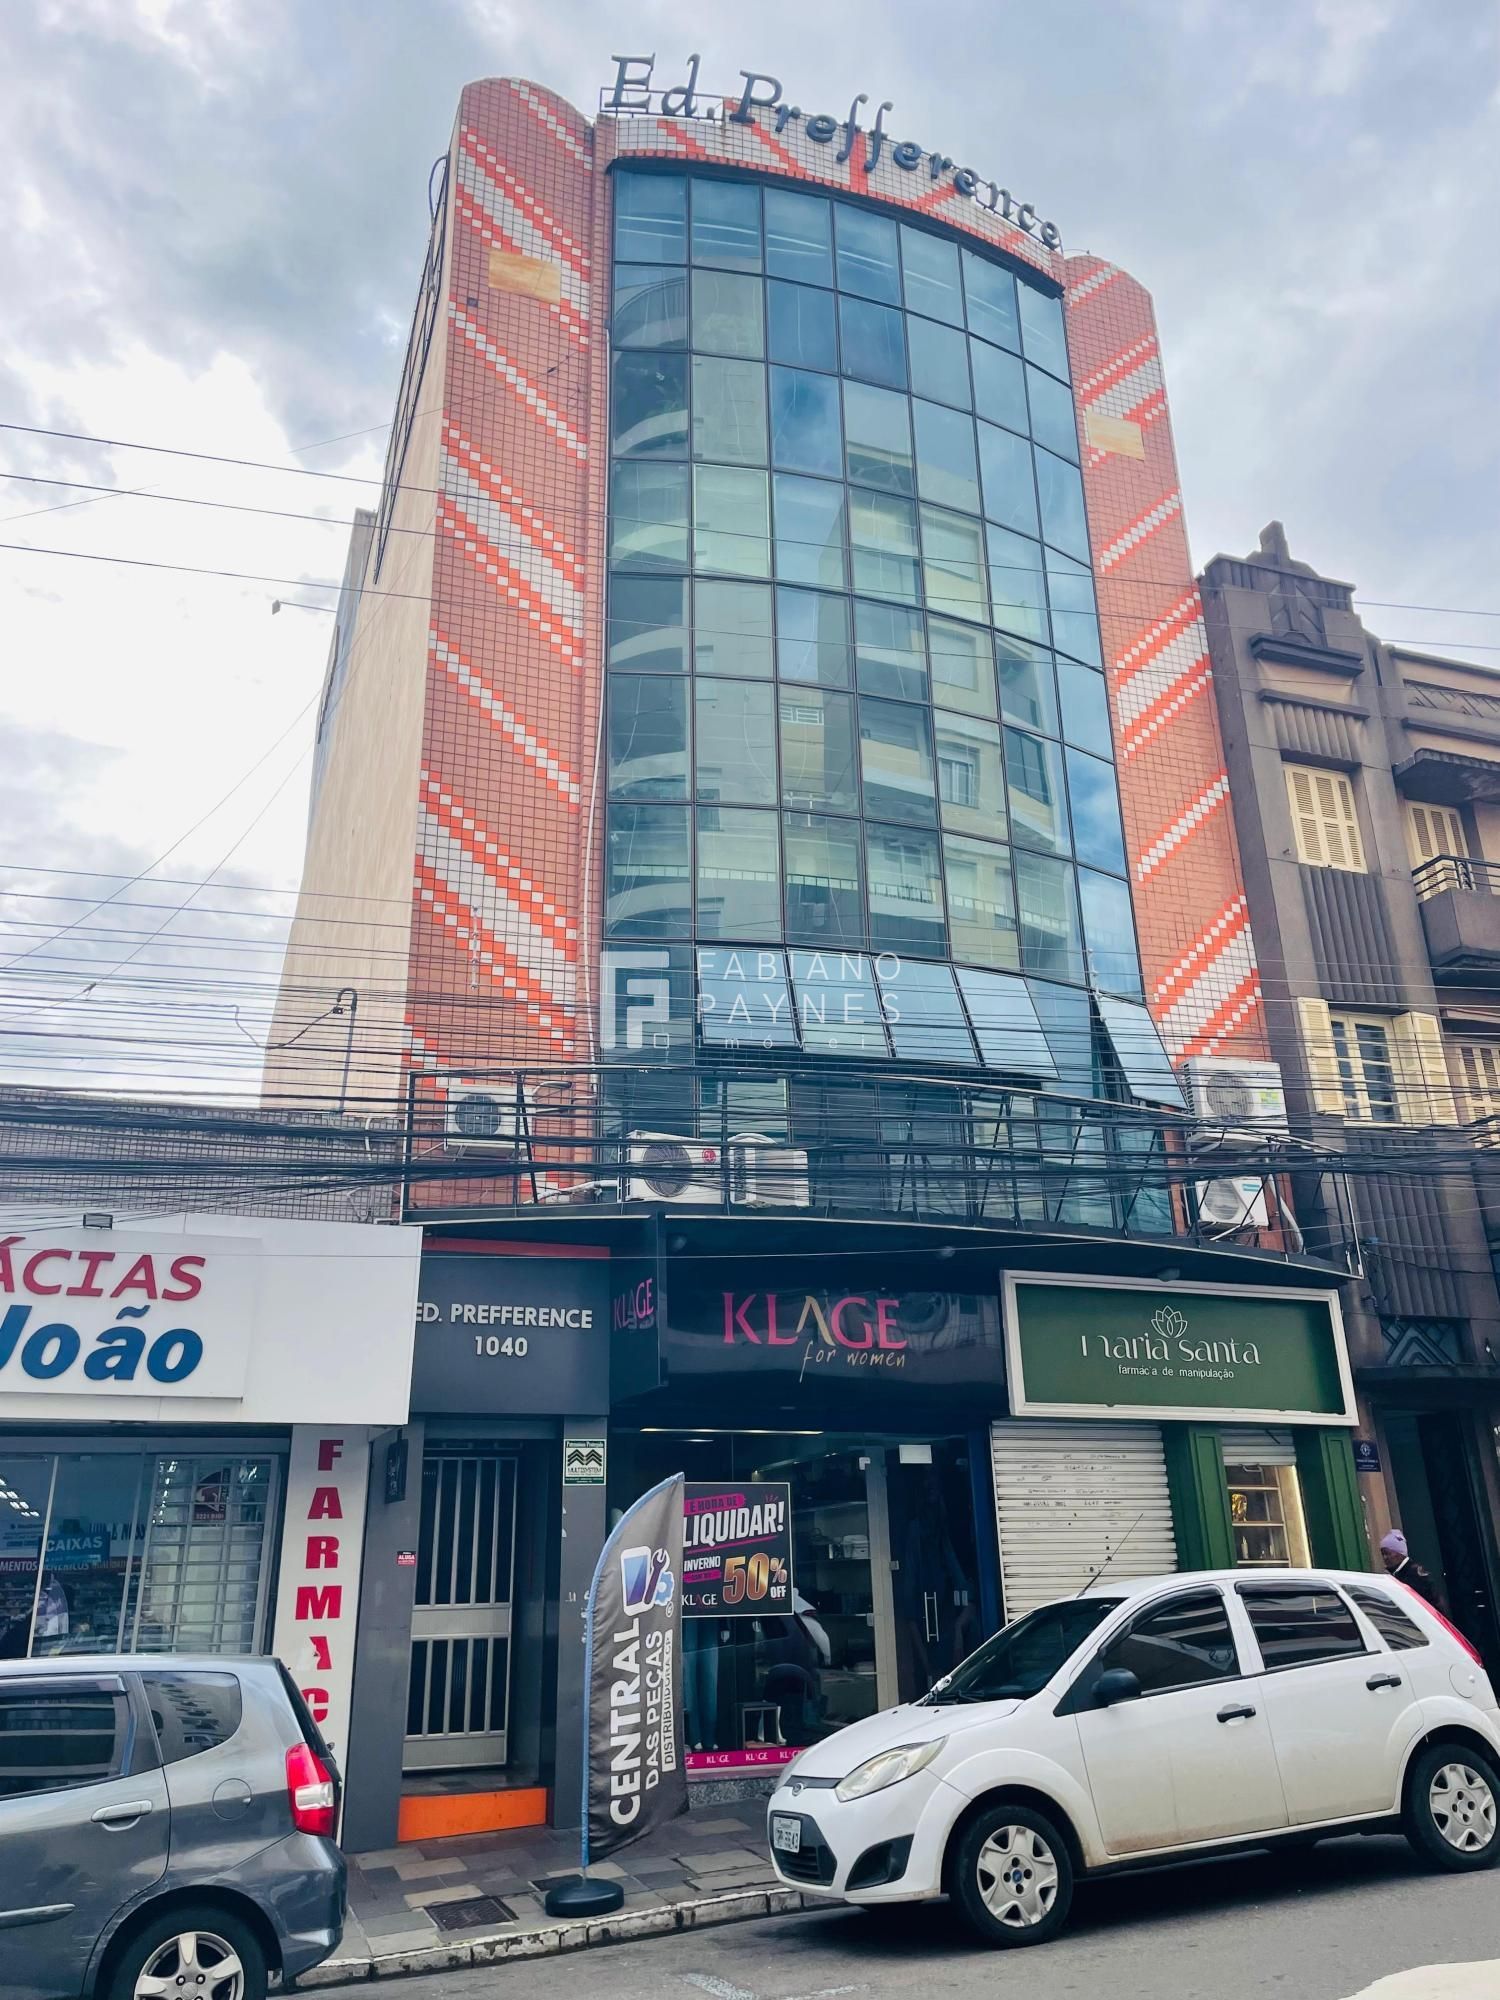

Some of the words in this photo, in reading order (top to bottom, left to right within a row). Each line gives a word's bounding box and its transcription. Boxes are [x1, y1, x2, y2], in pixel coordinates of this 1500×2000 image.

[604, 52, 715, 119] Ed.
[729, 69, 1062, 250] Prefference
[450, 1303, 593, 1329] PREFFERENCE
[722, 1292, 908, 1350] KLAGE
[475, 1336, 528, 1357] 1040
[799, 1340, 836, 1384] for
[847, 1351, 906, 1368] women
[1162, 1366, 1174, 1376] de
[1179, 1368, 1235, 1380] manipulação
[683, 1501, 785, 1547] LIQUIDAR!
[46, 1536, 104, 1552] CAIXAS
[684, 1556, 721, 1572] INVERNO
[722, 1552, 788, 1605] 50%
[770, 1585, 787, 1598] OFF
[610, 1617, 641, 1825] CENTRAL
[646, 1730, 660, 1791] DAS
[706, 1754, 729, 1764] KLGE
[745, 1751, 769, 1761] KLGE
